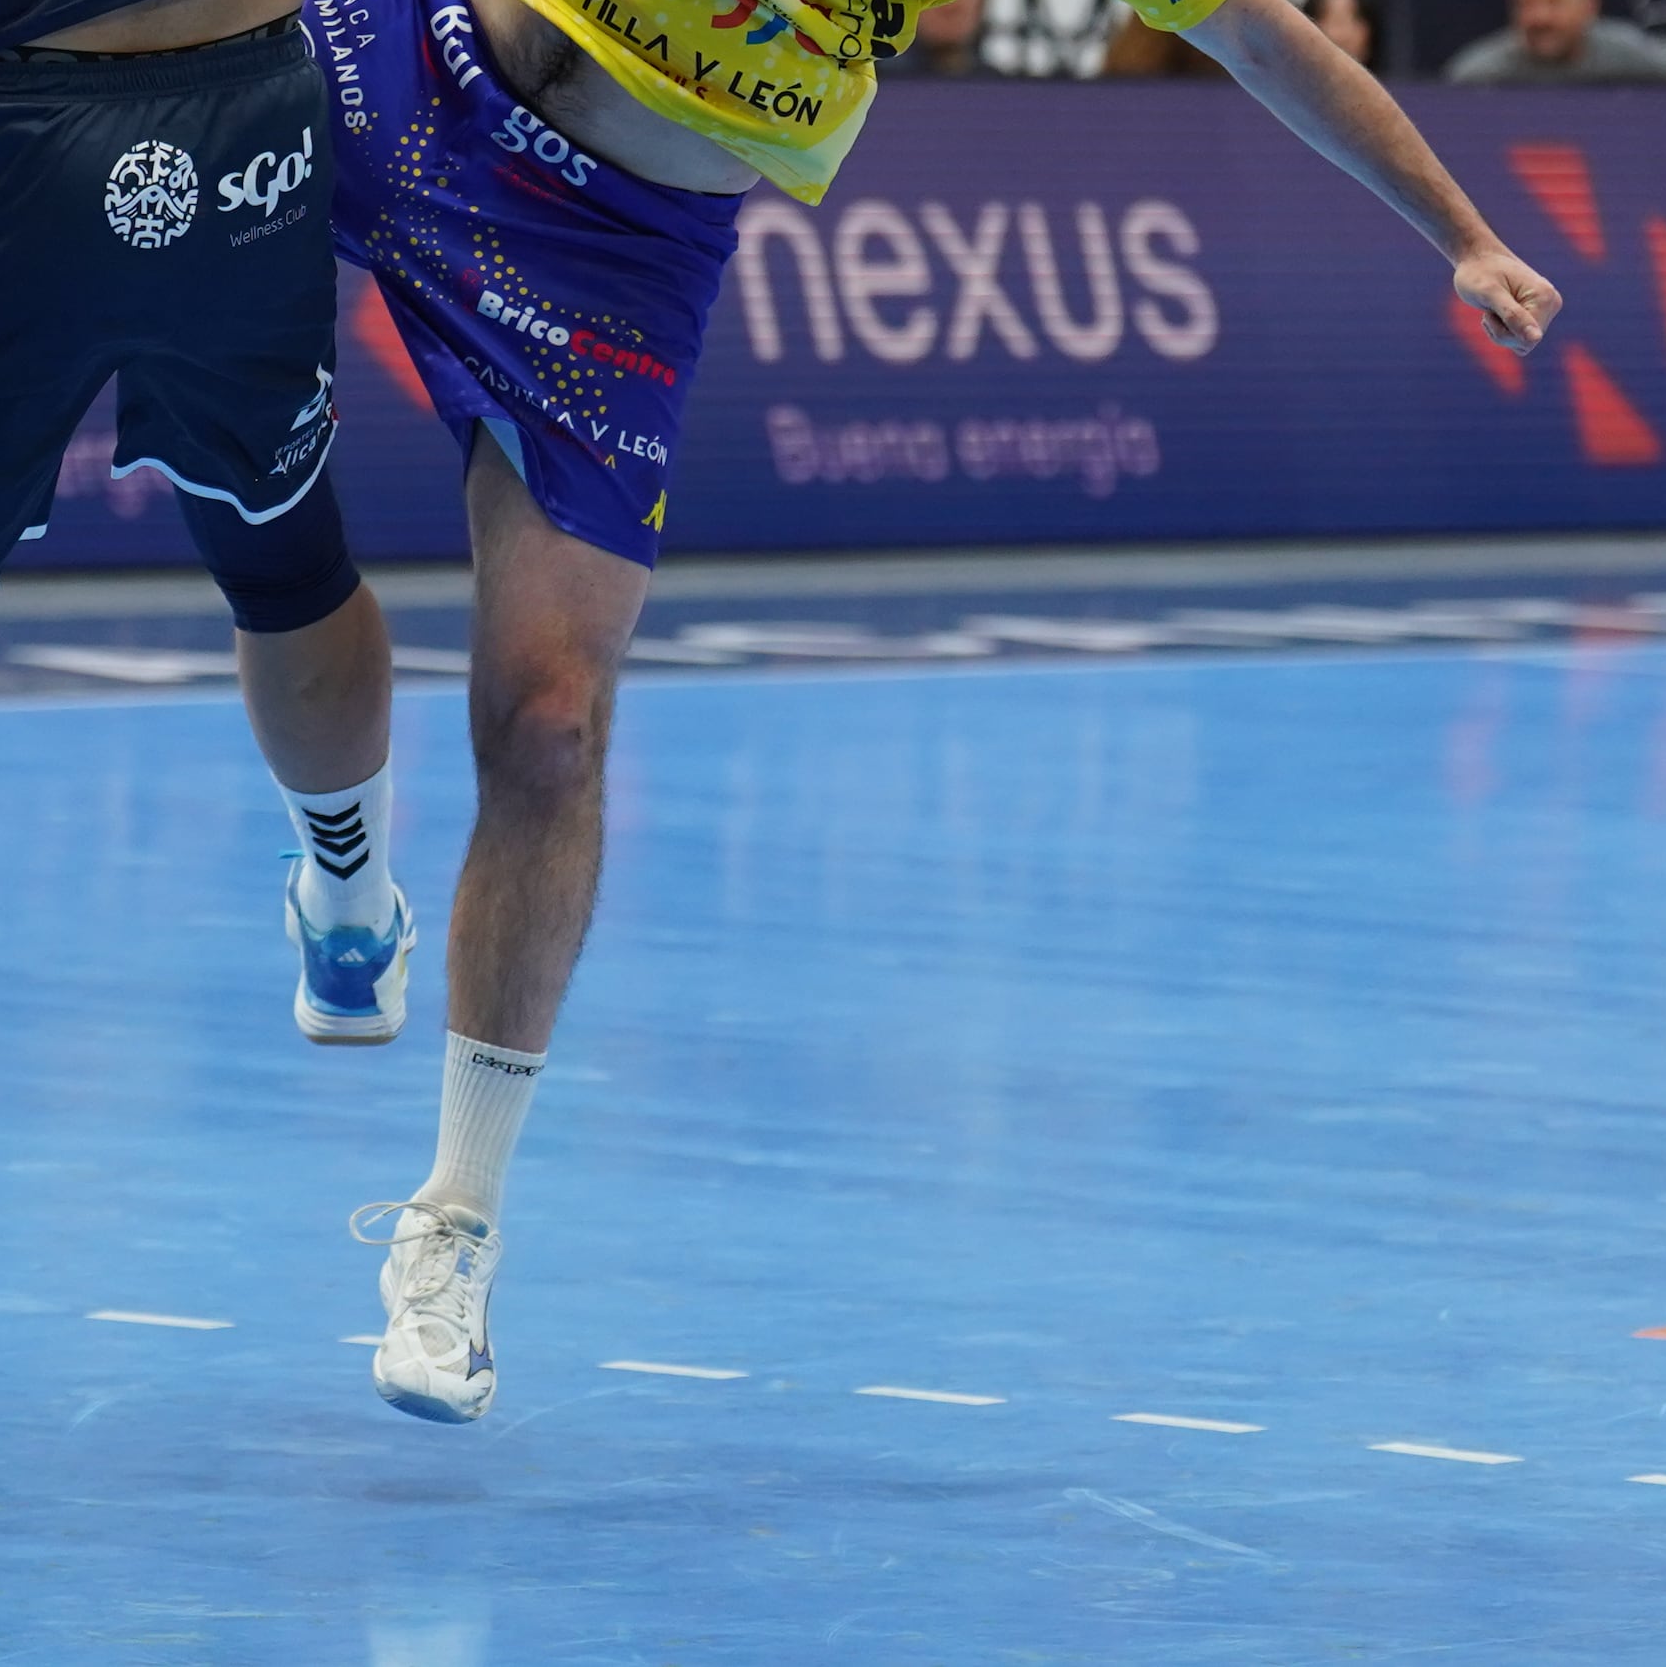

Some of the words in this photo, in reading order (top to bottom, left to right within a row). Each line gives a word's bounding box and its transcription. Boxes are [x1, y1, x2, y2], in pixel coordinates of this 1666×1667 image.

[694, 51, 721, 82] Y
[728, 70, 823, 127] LEÓN
[229, 217, 285, 247] Wellness
[285, 203, 308, 226] Club
[735, 198, 1221, 364] nexus
[617, 425, 669, 467] LEÓN
